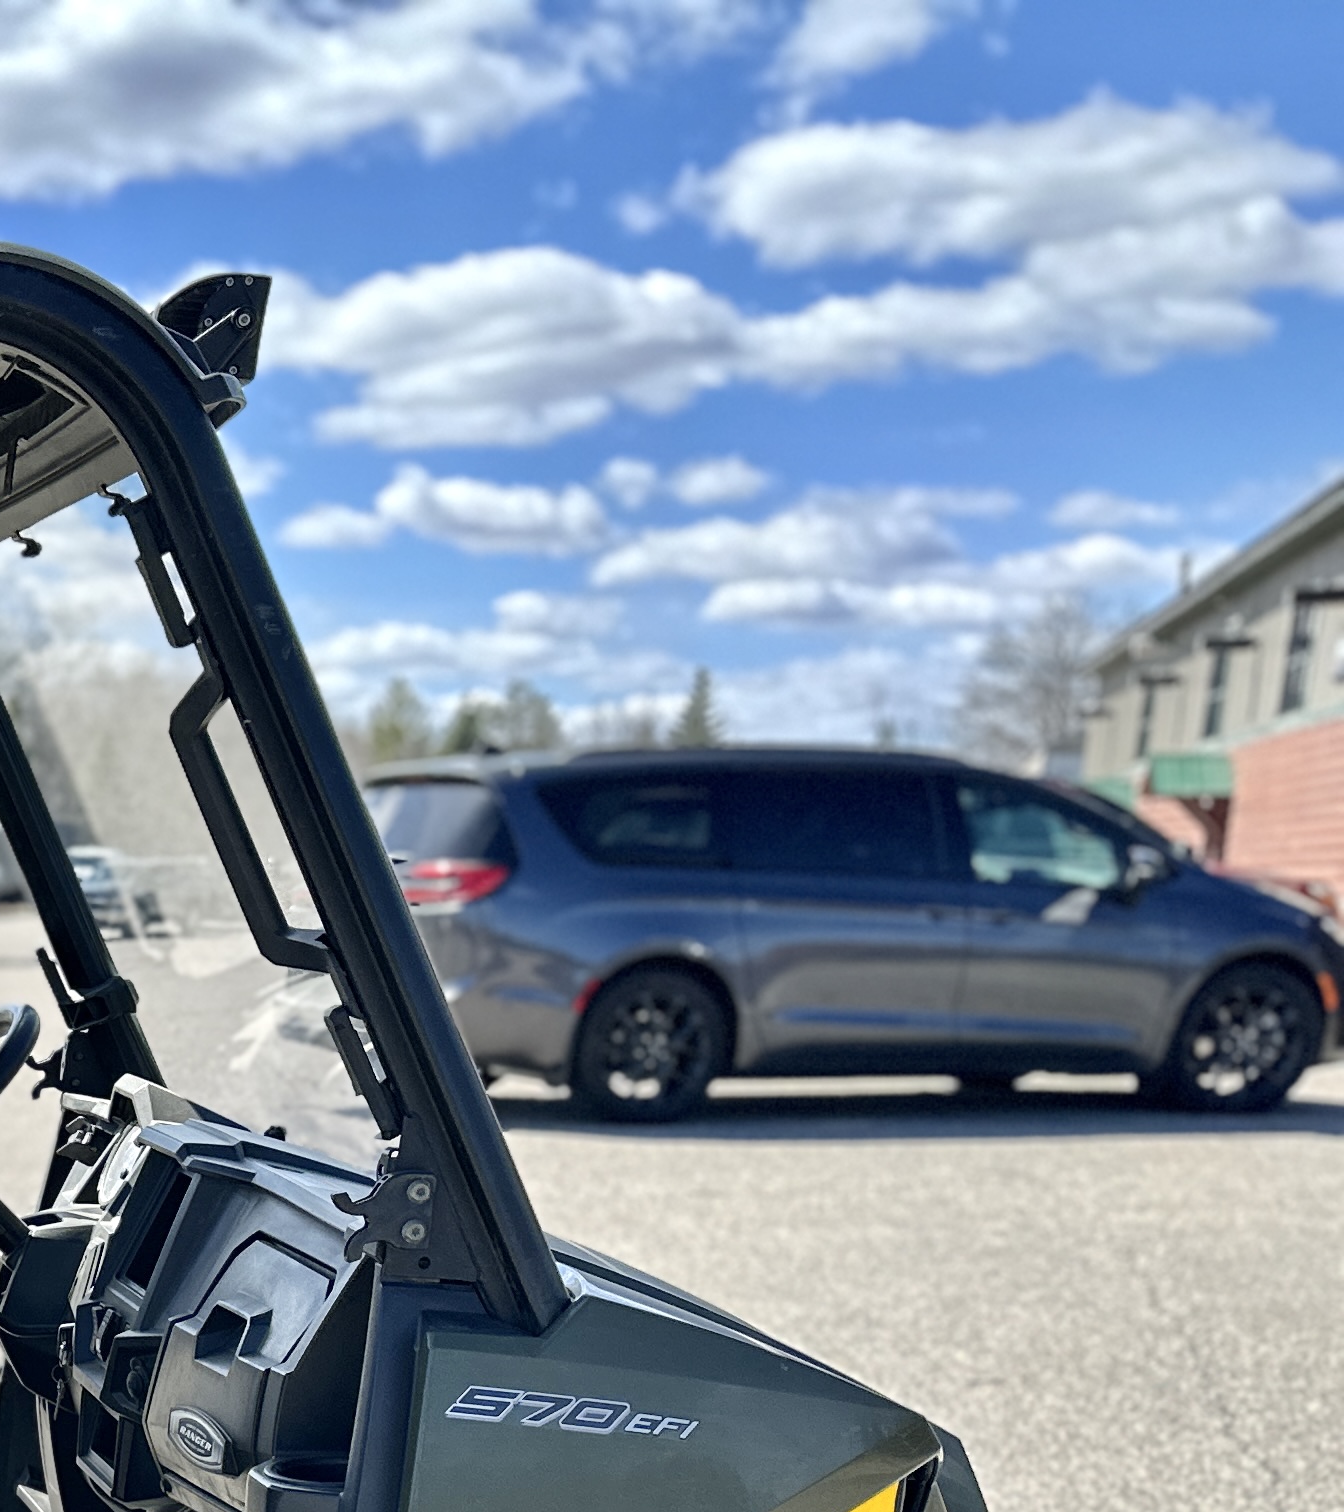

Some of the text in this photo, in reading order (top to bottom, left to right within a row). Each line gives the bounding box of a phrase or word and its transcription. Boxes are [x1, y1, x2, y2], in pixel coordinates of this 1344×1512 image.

[445, 1385, 699, 1440] 570 EFI
[179, 1425, 212, 1452] RANGER
